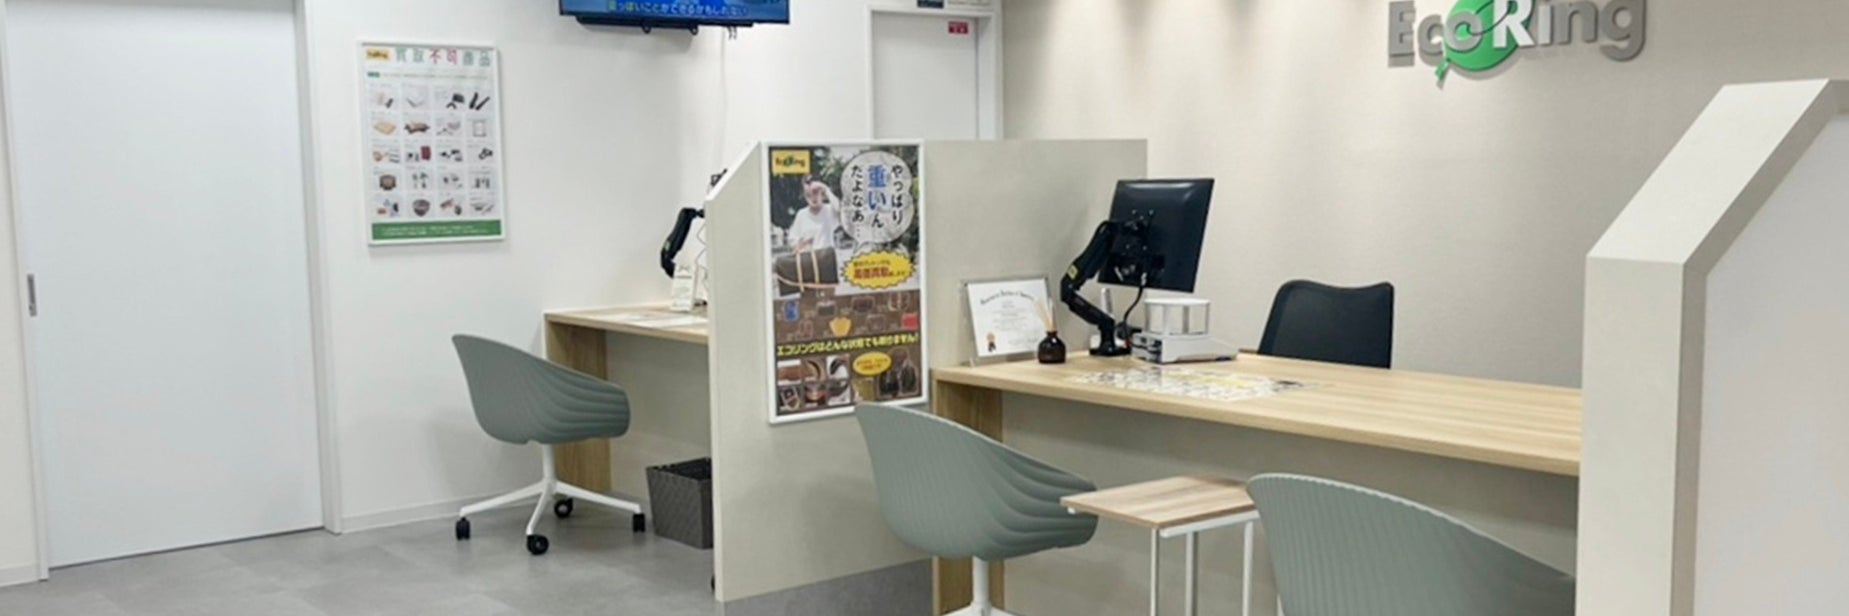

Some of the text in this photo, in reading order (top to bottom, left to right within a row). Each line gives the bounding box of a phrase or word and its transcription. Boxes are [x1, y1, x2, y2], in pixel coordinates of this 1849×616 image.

[1388, 0, 1646, 62] EcoRing
[867, 163, 887, 228] 重いん
[891, 164, 904, 225] やっぱり
